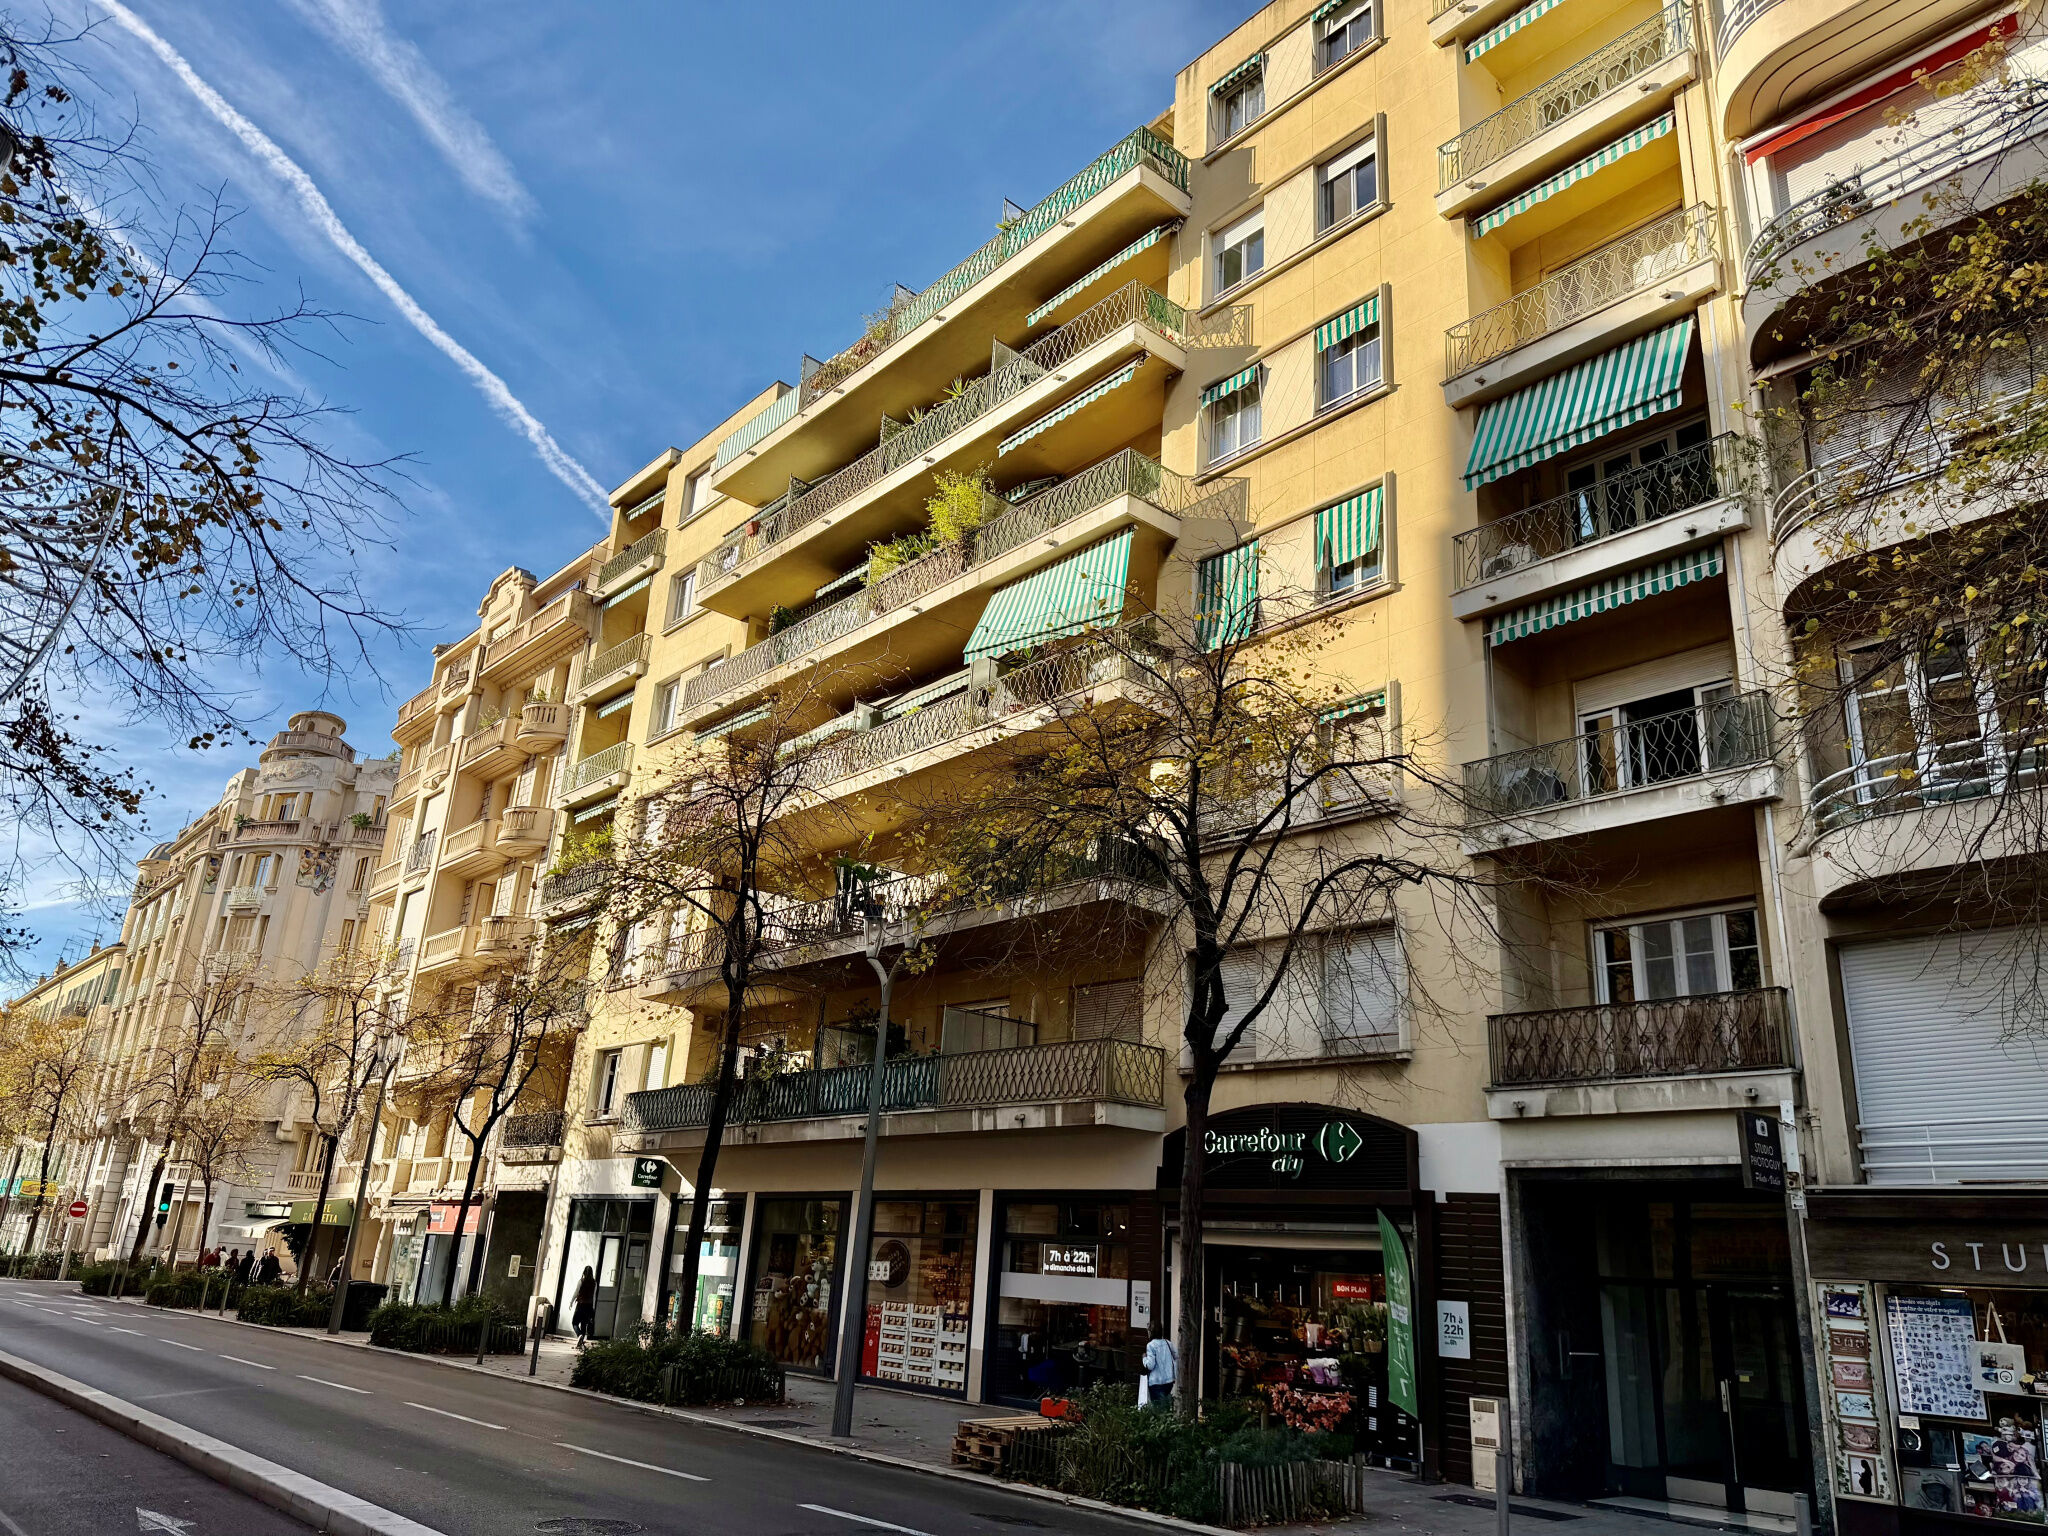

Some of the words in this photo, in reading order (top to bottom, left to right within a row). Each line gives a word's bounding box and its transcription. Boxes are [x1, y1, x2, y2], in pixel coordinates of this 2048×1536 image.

[1204, 1127, 1306, 1154] Carrefour
[1754, 1142, 1774, 1156] STUDIO
[1271, 1154, 1304, 1179] city
[637, 1173, 658, 1181] Carrefour
[1049, 1250, 1061, 1262] 7h
[1073, 1252, 1090, 1263] 22h
[1931, 1241, 2048, 1273] STU
[1050, 1264, 1076, 1272] dimanche
[1087, 1265, 1095, 1273] 8h
[1350, 1286, 1367, 1294] PLAN
[1443, 1312, 1456, 1323] 7h
[1444, 1324, 1464, 1335] 22h
